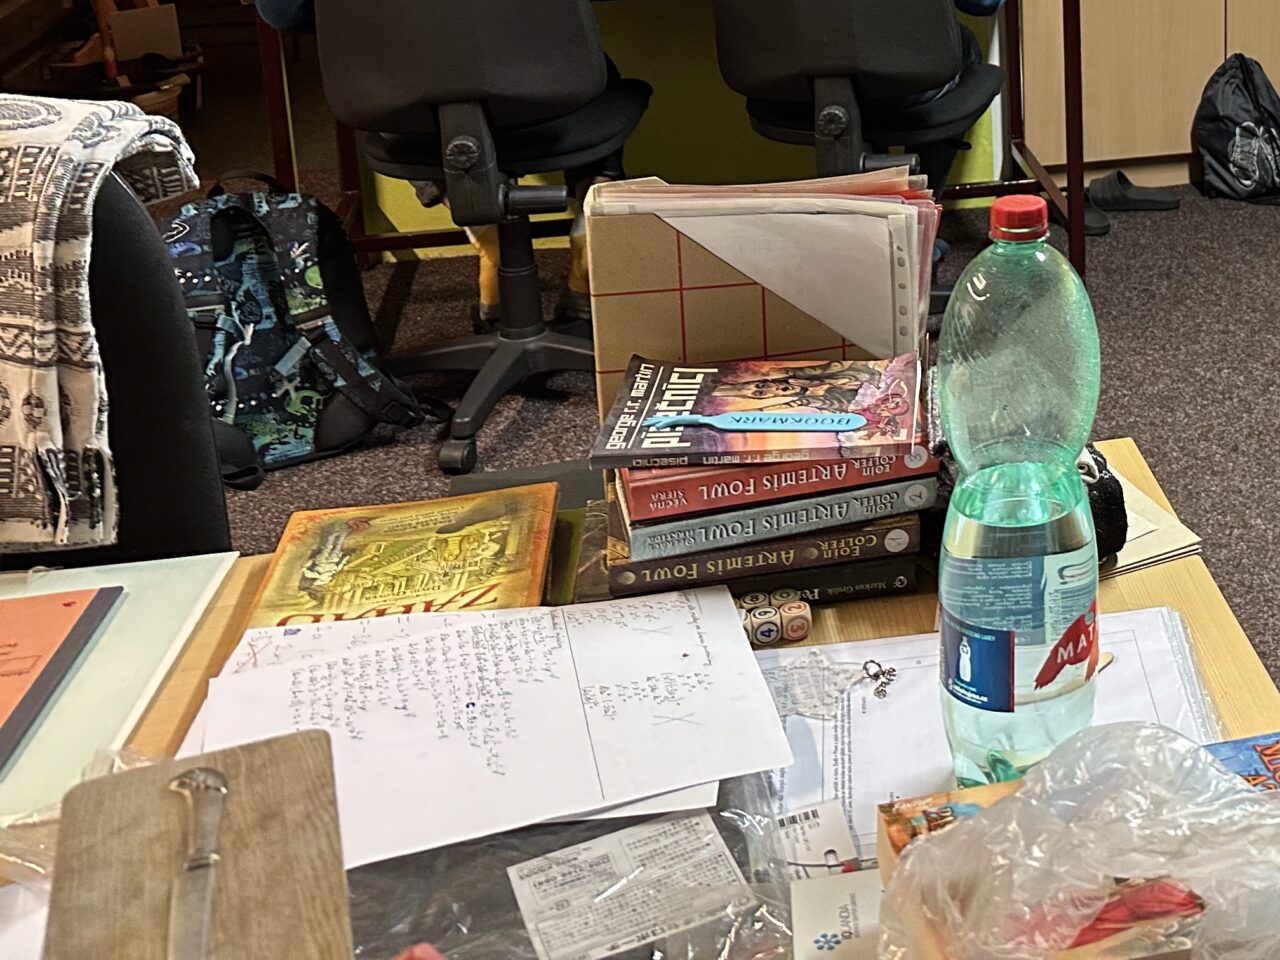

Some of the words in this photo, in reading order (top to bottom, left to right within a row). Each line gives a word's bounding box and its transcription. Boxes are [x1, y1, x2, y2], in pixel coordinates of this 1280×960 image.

[605, 414, 637, 450] george
[630, 363, 655, 398] martin
[730, 415, 851, 426] BOOKMARK
[703, 455, 740, 465] martin
[698, 478, 756, 500] FOWL
[851, 492, 899, 507] COLFER
[697, 518, 757, 539] FOWL
[818, 534, 877, 551] COLFER
[641, 563, 699, 582] FOWL
[855, 581, 887, 591] Markus
[799, 588, 820, 601] Pe
